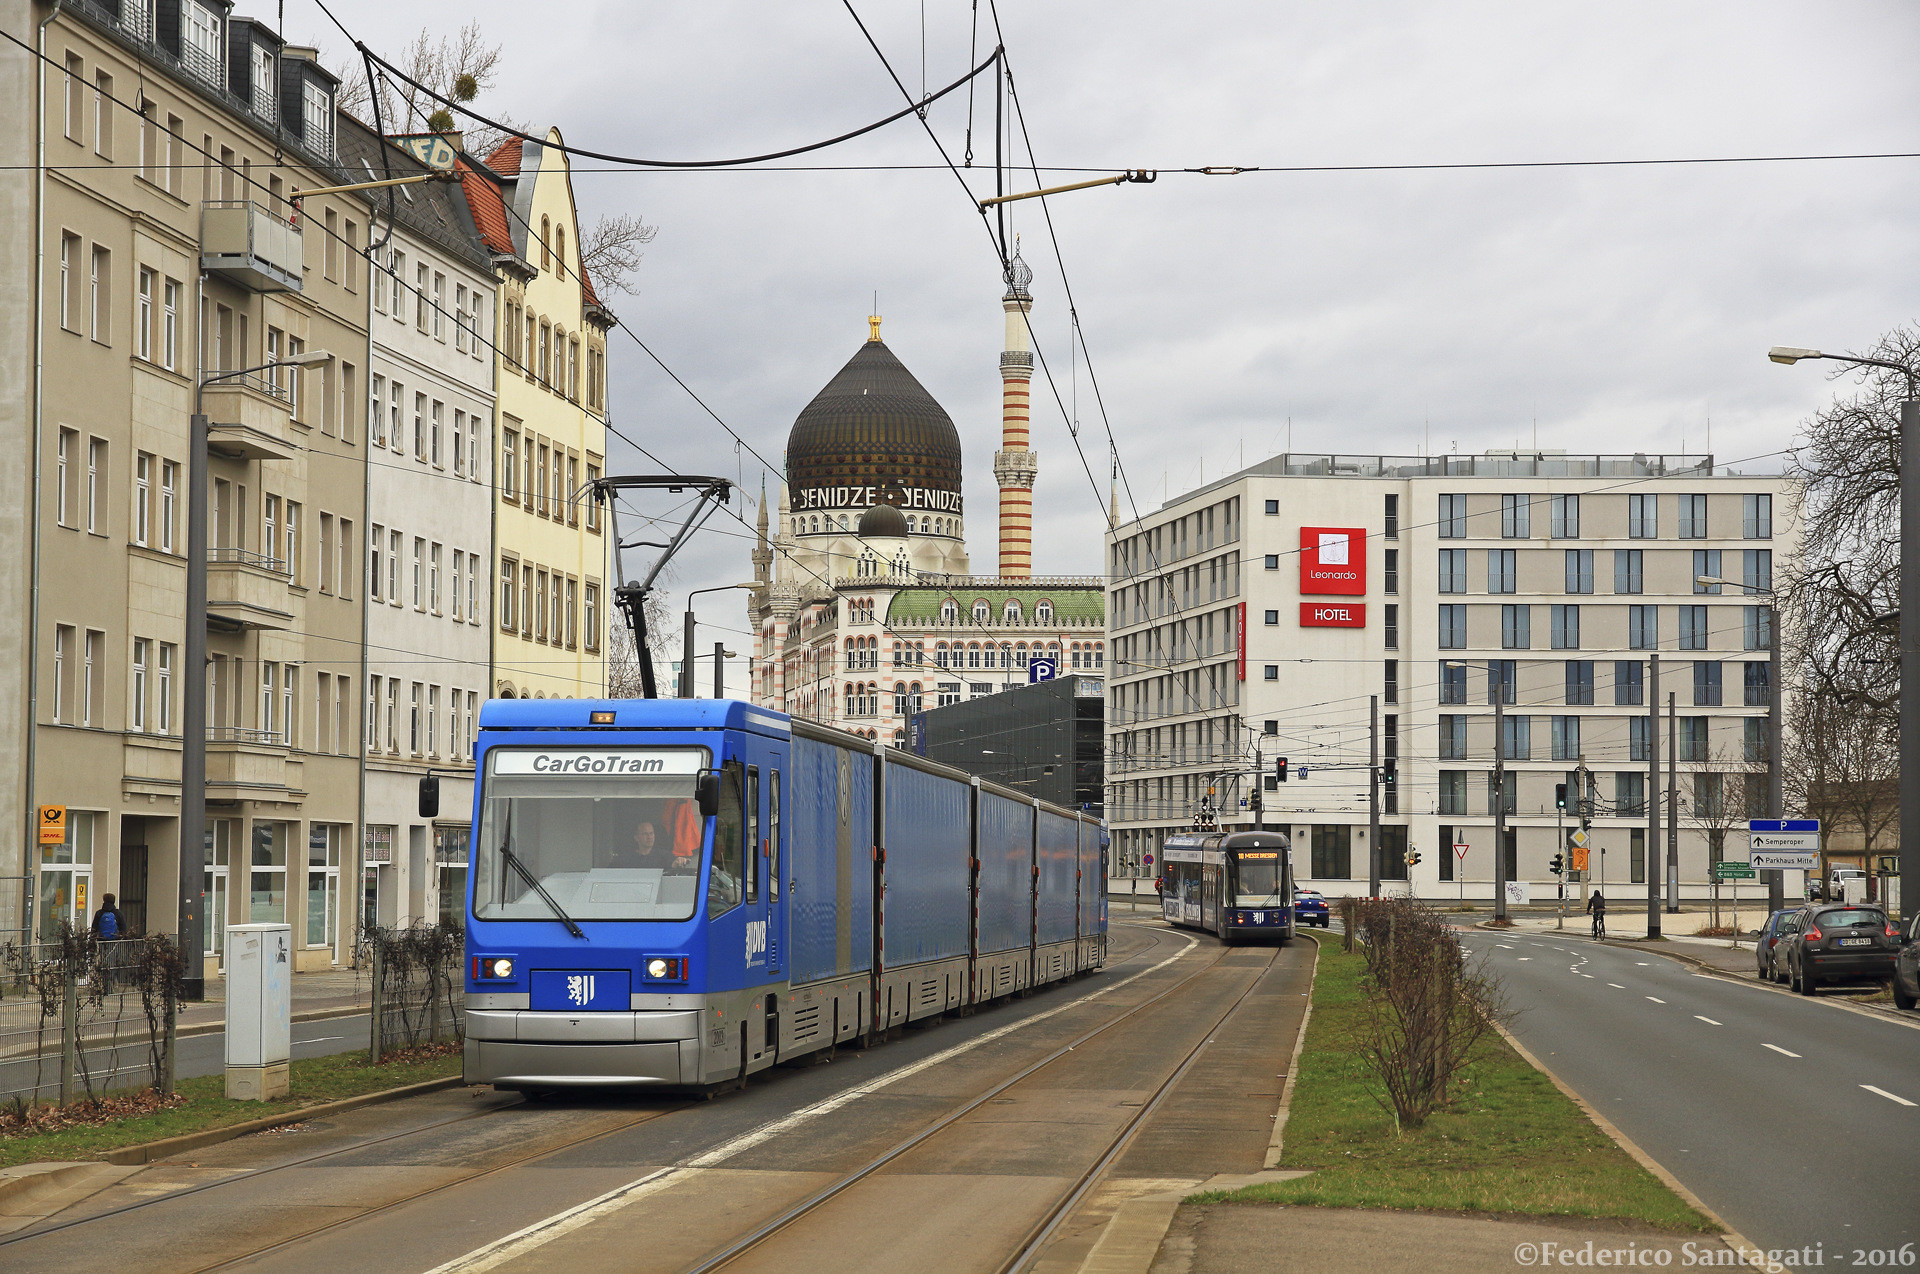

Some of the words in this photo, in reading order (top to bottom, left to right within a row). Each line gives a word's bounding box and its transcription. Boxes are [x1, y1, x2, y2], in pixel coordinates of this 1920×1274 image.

[800, 486, 876, 509] YENIDZE
[901, 487, 961, 512] YENIDZE
[1310, 569, 1357, 580] Leonardo
[1314, 608, 1352, 621] HOTEL
[1036, 665, 1050, 682] P
[532, 754, 664, 773] CarGoTram
[1298, 768, 1308, 776] W
[1780, 821, 1788, 831] P
